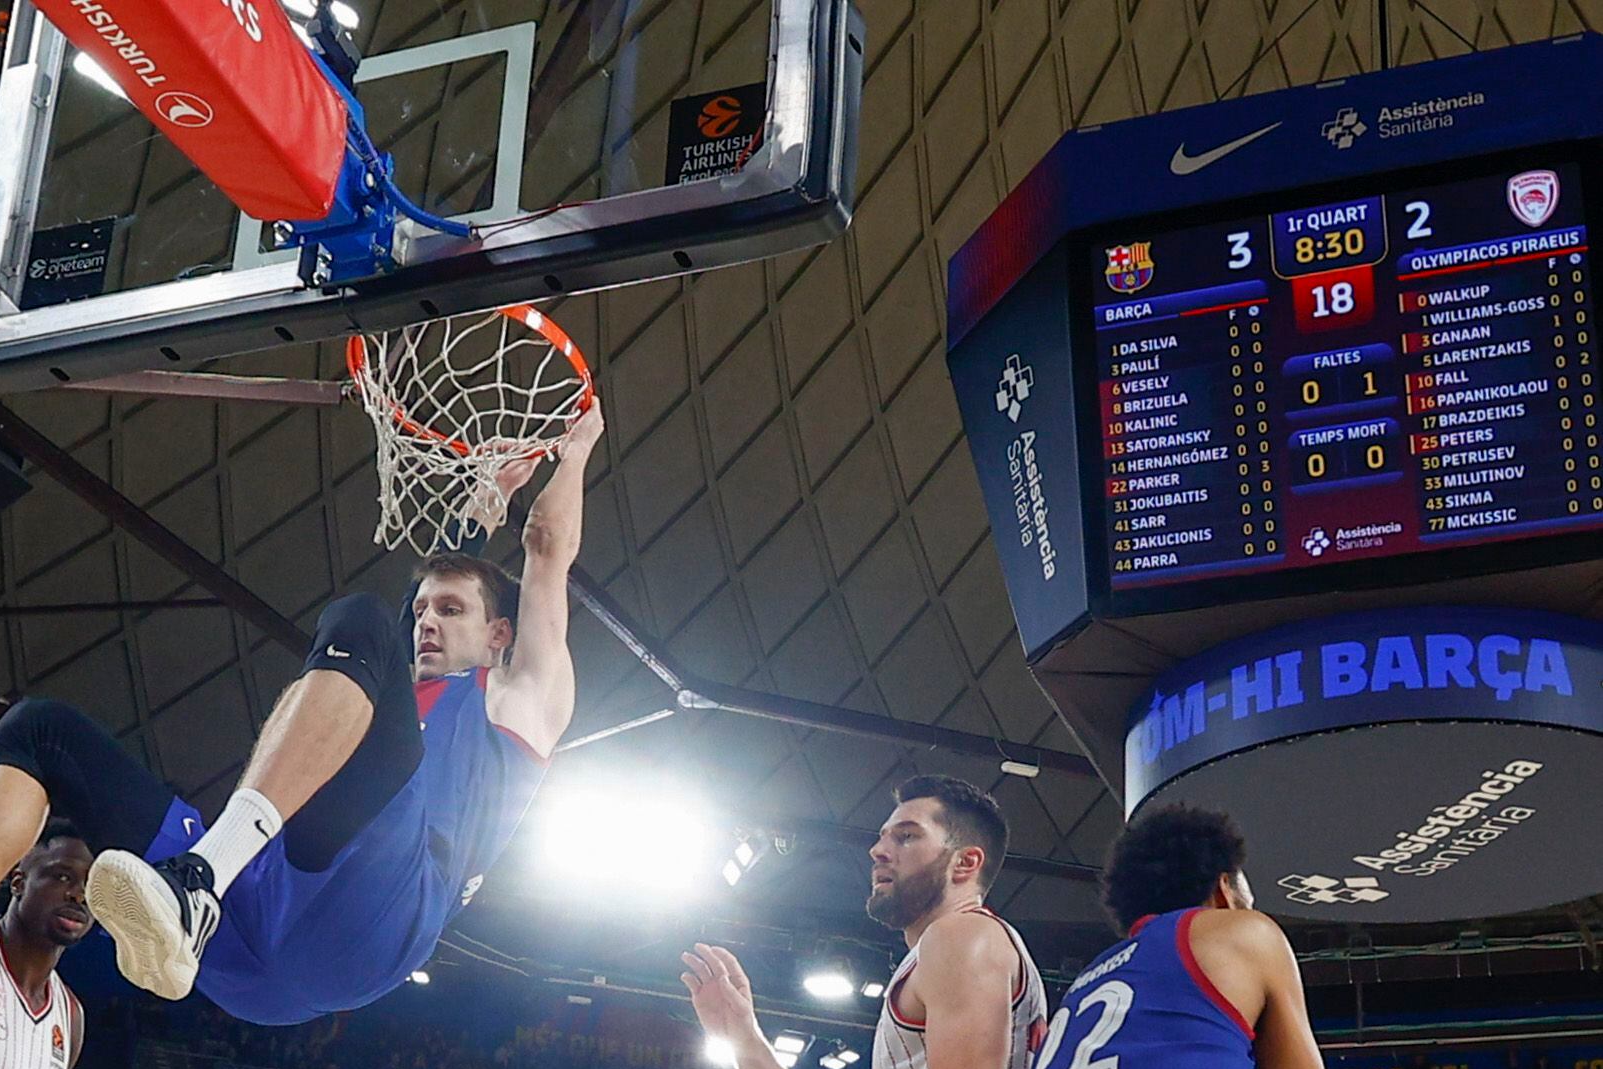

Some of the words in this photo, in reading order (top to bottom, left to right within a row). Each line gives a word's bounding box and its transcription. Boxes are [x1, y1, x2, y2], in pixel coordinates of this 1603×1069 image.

[1378, 91, 1485, 123] Assistència
[1379, 112, 1453, 138] Sanitària
[683, 134, 754, 158] TURKISH
[1287, 217, 1304, 233] 1r
[1307, 204, 1368, 231] QUART
[1405, 201, 1432, 239] 2
[1227, 232, 1252, 269] 3
[1296, 228, 1364, 263] 8:30
[1411, 243, 1508, 271] OLYMPIACOS
[1512, 231, 1579, 255] PIRAEUS
[1311, 282, 1354, 318] 18
[1418, 295, 1427, 306] 0
[1429, 285, 1490, 305] WALKUP
[1549, 274, 1558, 286] 0
[1572, 270, 1582, 282] 0
[1105, 303, 1152, 321] BARÇA
[1422, 315, 1428, 326] 1
[1430, 298, 1545, 326] WILLIAMS-GOSS
[1550, 294, 1560, 306] 0
[1574, 291, 1584, 302] 0
[1112, 346, 1118, 356] 1
[1120, 342, 1138, 355] DA
[1140, 336, 1177, 351] SILVA
[1230, 326, 1238, 337] 0
[1252, 322, 1260, 333] 0
[1422, 335, 1430, 346] 3
[1432, 326, 1491, 344] CANAAN
[1554, 315, 1560, 326] 1
[1576, 311, 1586, 323] 0
[1112, 365, 1119, 376] 3
[1121, 355, 1160, 374] PAULÍ
[1231, 346, 1240, 356] 0
[1253, 342, 1261, 353] 0
[1314, 350, 1361, 369] FALTES
[1424, 355, 1432, 366] 5
[1434, 340, 1531, 365] LARENTZAKIS
[1554, 335, 1563, 347] 0
[1578, 332, 1587, 344] 0
[1113, 384, 1120, 396] 6
[1122, 376, 1169, 394] VESELY
[1232, 365, 1241, 376] 0
[1254, 362, 1262, 373] 0
[1303, 380, 1320, 404] 0
[1363, 371, 1378, 395] 1
[1418, 376, 1433, 388] 10
[1435, 370, 1469, 386] FALL
[1556, 356, 1565, 368] 0
[1581, 353, 1589, 364] 2
[1114, 404, 1121, 414] 8
[1124, 394, 1188, 413] BRIZUELA
[1234, 385, 1242, 396] 0
[1256, 381, 1264, 392] 0
[1420, 397, 1435, 408] 16
[1437, 380, 1548, 406] PAPANIKOLAOU
[1558, 377, 1567, 389] 0
[1582, 374, 1591, 386] 0
[1109, 423, 1122, 434] 10
[1125, 415, 1178, 432] KALINIC
[1235, 404, 1244, 416] 0
[1257, 401, 1265, 412] 0
[1422, 417, 1436, 429] 17
[1439, 404, 1525, 427] BRAZDEIKIS
[1560, 398, 1568, 410] 0
[1584, 394, 1593, 406] 0
[1111, 443, 1124, 454] 13
[1126, 430, 1211, 452] SATORANSKY
[1236, 424, 1245, 436] 0
[1258, 421, 1267, 432] 0
[1299, 429, 1344, 447] TEMPS
[1348, 423, 1386, 440] MORT
[1422, 437, 1438, 449] 25
[1440, 428, 1493, 446] PETERS
[1562, 418, 1570, 430] 0
[1586, 415, 1595, 426] 0
[1112, 462, 1125, 474] 14
[1127, 447, 1228, 472] HERNANGÓMEZ
[1238, 444, 1246, 456] 0
[1260, 441, 1268, 452] 0
[1308, 453, 1325, 477] 0
[1367, 445, 1385, 469] 0
[1422, 457, 1440, 470] 30
[1442, 446, 1515, 467] PETRUSEV
[1563, 438, 1572, 450] 0
[1588, 435, 1596, 447] 0
[1112, 482, 1127, 493] 22
[1128, 474, 1180, 491] PARKER
[1239, 464, 1248, 476] 0
[1262, 461, 1270, 472] 3
[1425, 478, 1442, 490] 33
[1444, 466, 1525, 488] MILUTINOV
[1565, 459, 1574, 471] 0
[1590, 456, 1598, 468] 0
[1007, 439, 1033, 547] Sanitària
[1020, 430, 1056, 580] Assistència
[1115, 500, 1128, 512] 31
[1130, 490, 1208, 511] JOKUBAITIS
[1240, 484, 1249, 495] 0
[1263, 480, 1271, 492] 0
[1426, 498, 1443, 510] 43
[1446, 491, 1493, 508] SIKMA
[1567, 480, 1576, 492] 0
[1591, 476, 1600, 488] 0
[1115, 520, 1128, 531] 41
[1131, 515, 1166, 530] SARR
[1242, 504, 1250, 515] 0
[1264, 500, 1273, 512] 0
[1335, 522, 1402, 540] Assistència
[1430, 518, 1444, 530] 77
[1448, 509, 1516, 529] MCKISSIC
[1569, 500, 1578, 512] 0
[1593, 498, 1603, 510] 0
[1115, 540, 1130, 551] 43
[1132, 529, 1212, 550] JAKUCIONIS
[1244, 524, 1252, 535] 0
[1266, 520, 1274, 532] 0
[1115, 560, 1132, 571] 44
[1134, 553, 1178, 570] PARRA
[1245, 544, 1254, 555] 0
[1267, 540, 1276, 552] 0
[1321, 634, 1573, 700] BARÇA
[1352, 758, 1544, 871] Assistència
[1394, 805, 1536, 877] Sanitària
